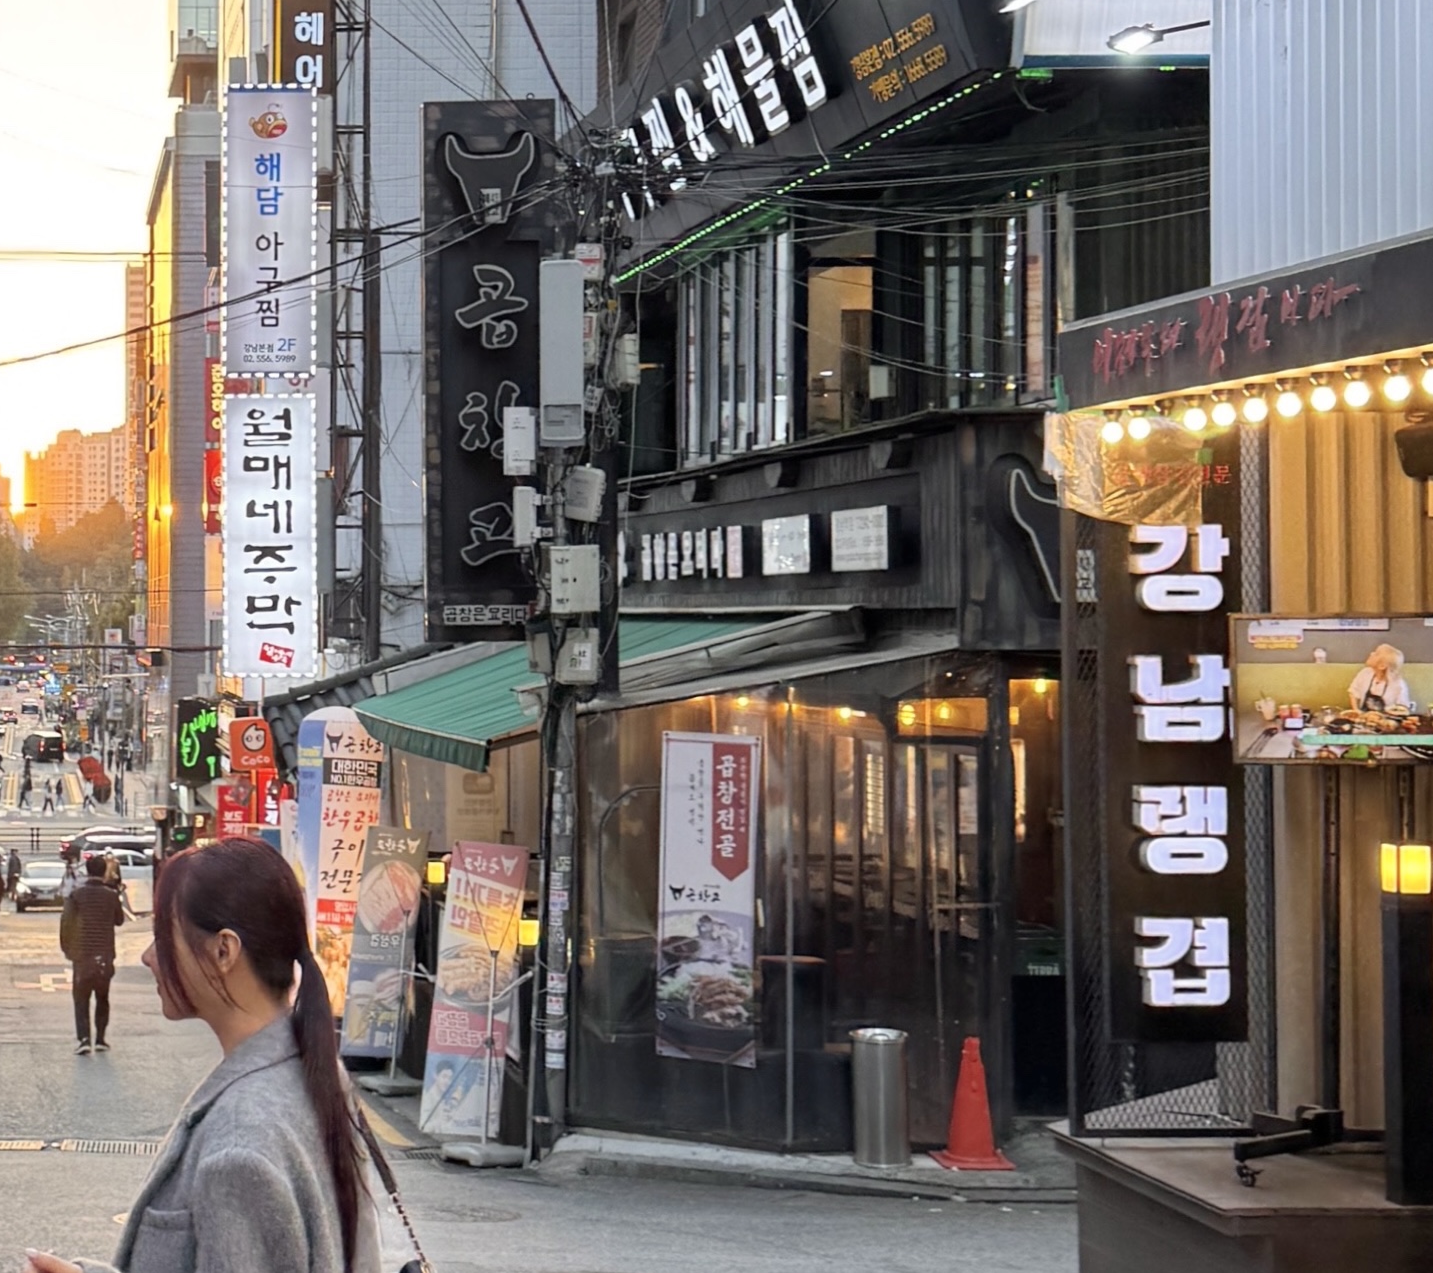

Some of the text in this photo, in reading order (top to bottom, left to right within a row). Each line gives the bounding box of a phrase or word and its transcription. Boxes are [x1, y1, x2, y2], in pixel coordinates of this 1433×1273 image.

[253, 151, 284, 217] 해담
[277, 337, 297, 353] 2F
[331, 758, 380, 776] 대한민국
[715, 754, 737, 859] 곱창전골
[319, 868, 362, 895] 전문
